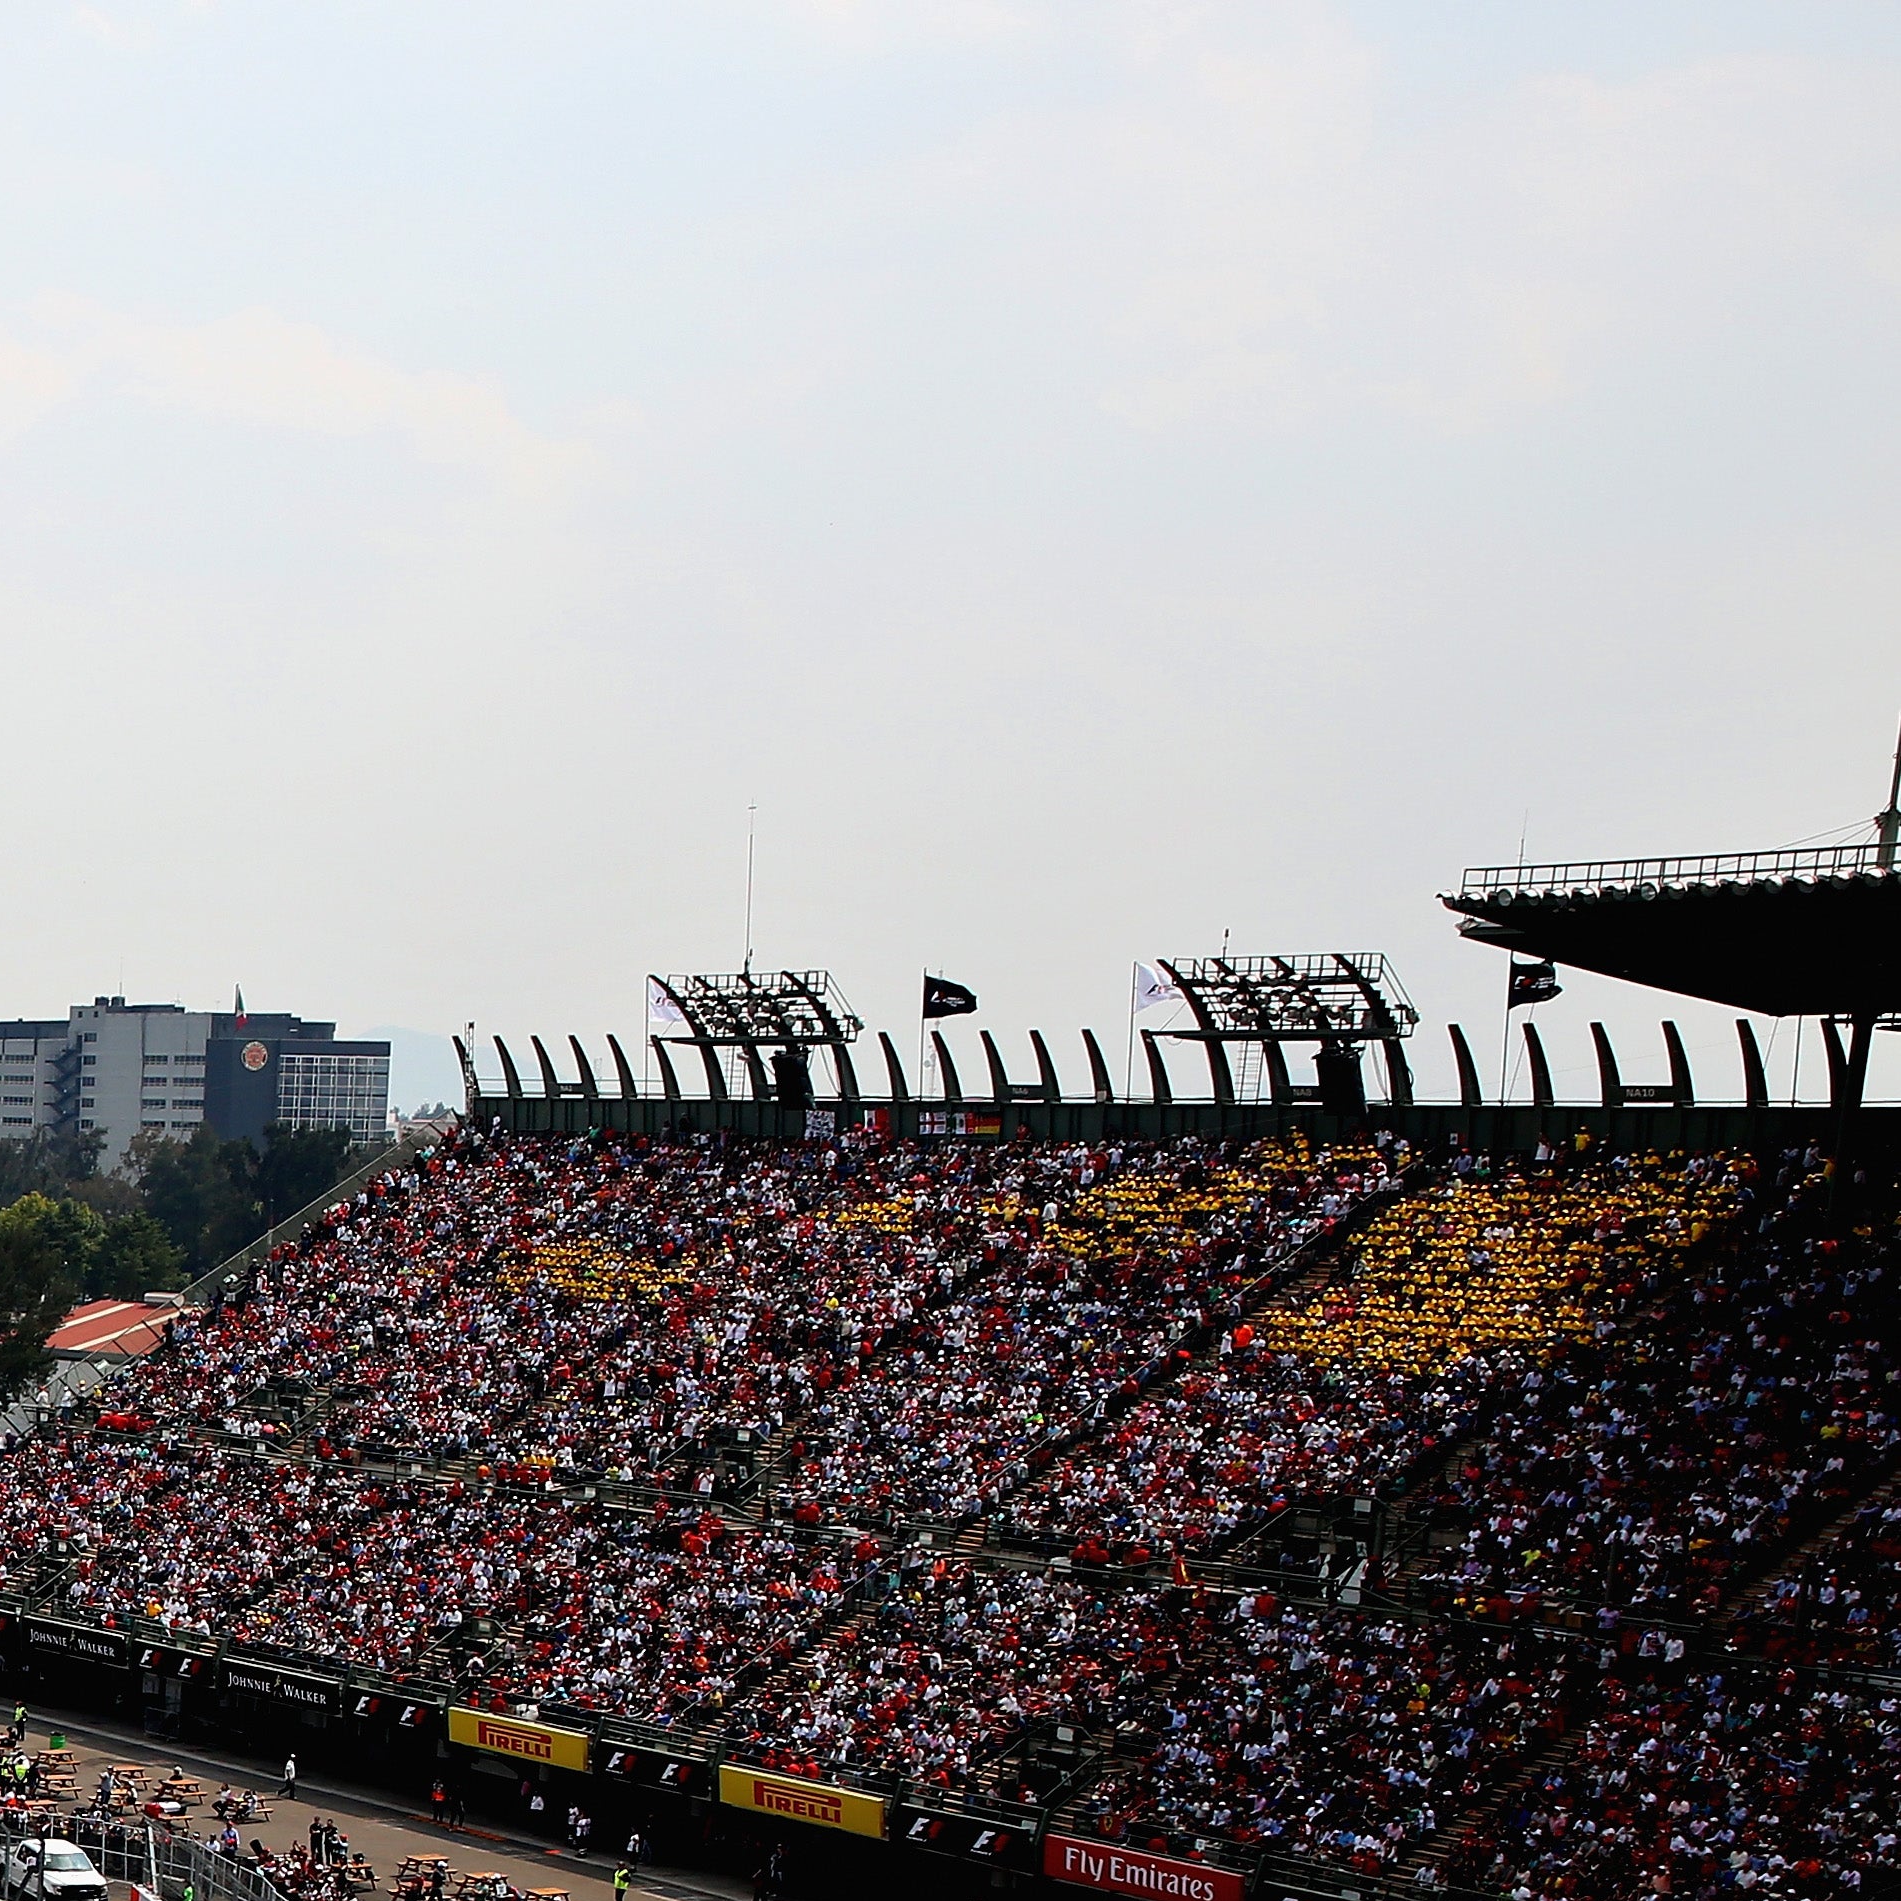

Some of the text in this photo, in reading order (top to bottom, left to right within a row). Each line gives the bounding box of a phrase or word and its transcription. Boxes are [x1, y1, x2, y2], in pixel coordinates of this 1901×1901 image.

[29, 1628, 116, 1658] JOHNNIE WALKER
[228, 1672, 327, 1705] JOHNNIE WALKER
[478, 1720, 553, 1759] PIRELLI
[753, 1779, 842, 1824] PIRELLI
[1065, 1846, 1214, 1901] Fly Emirates
